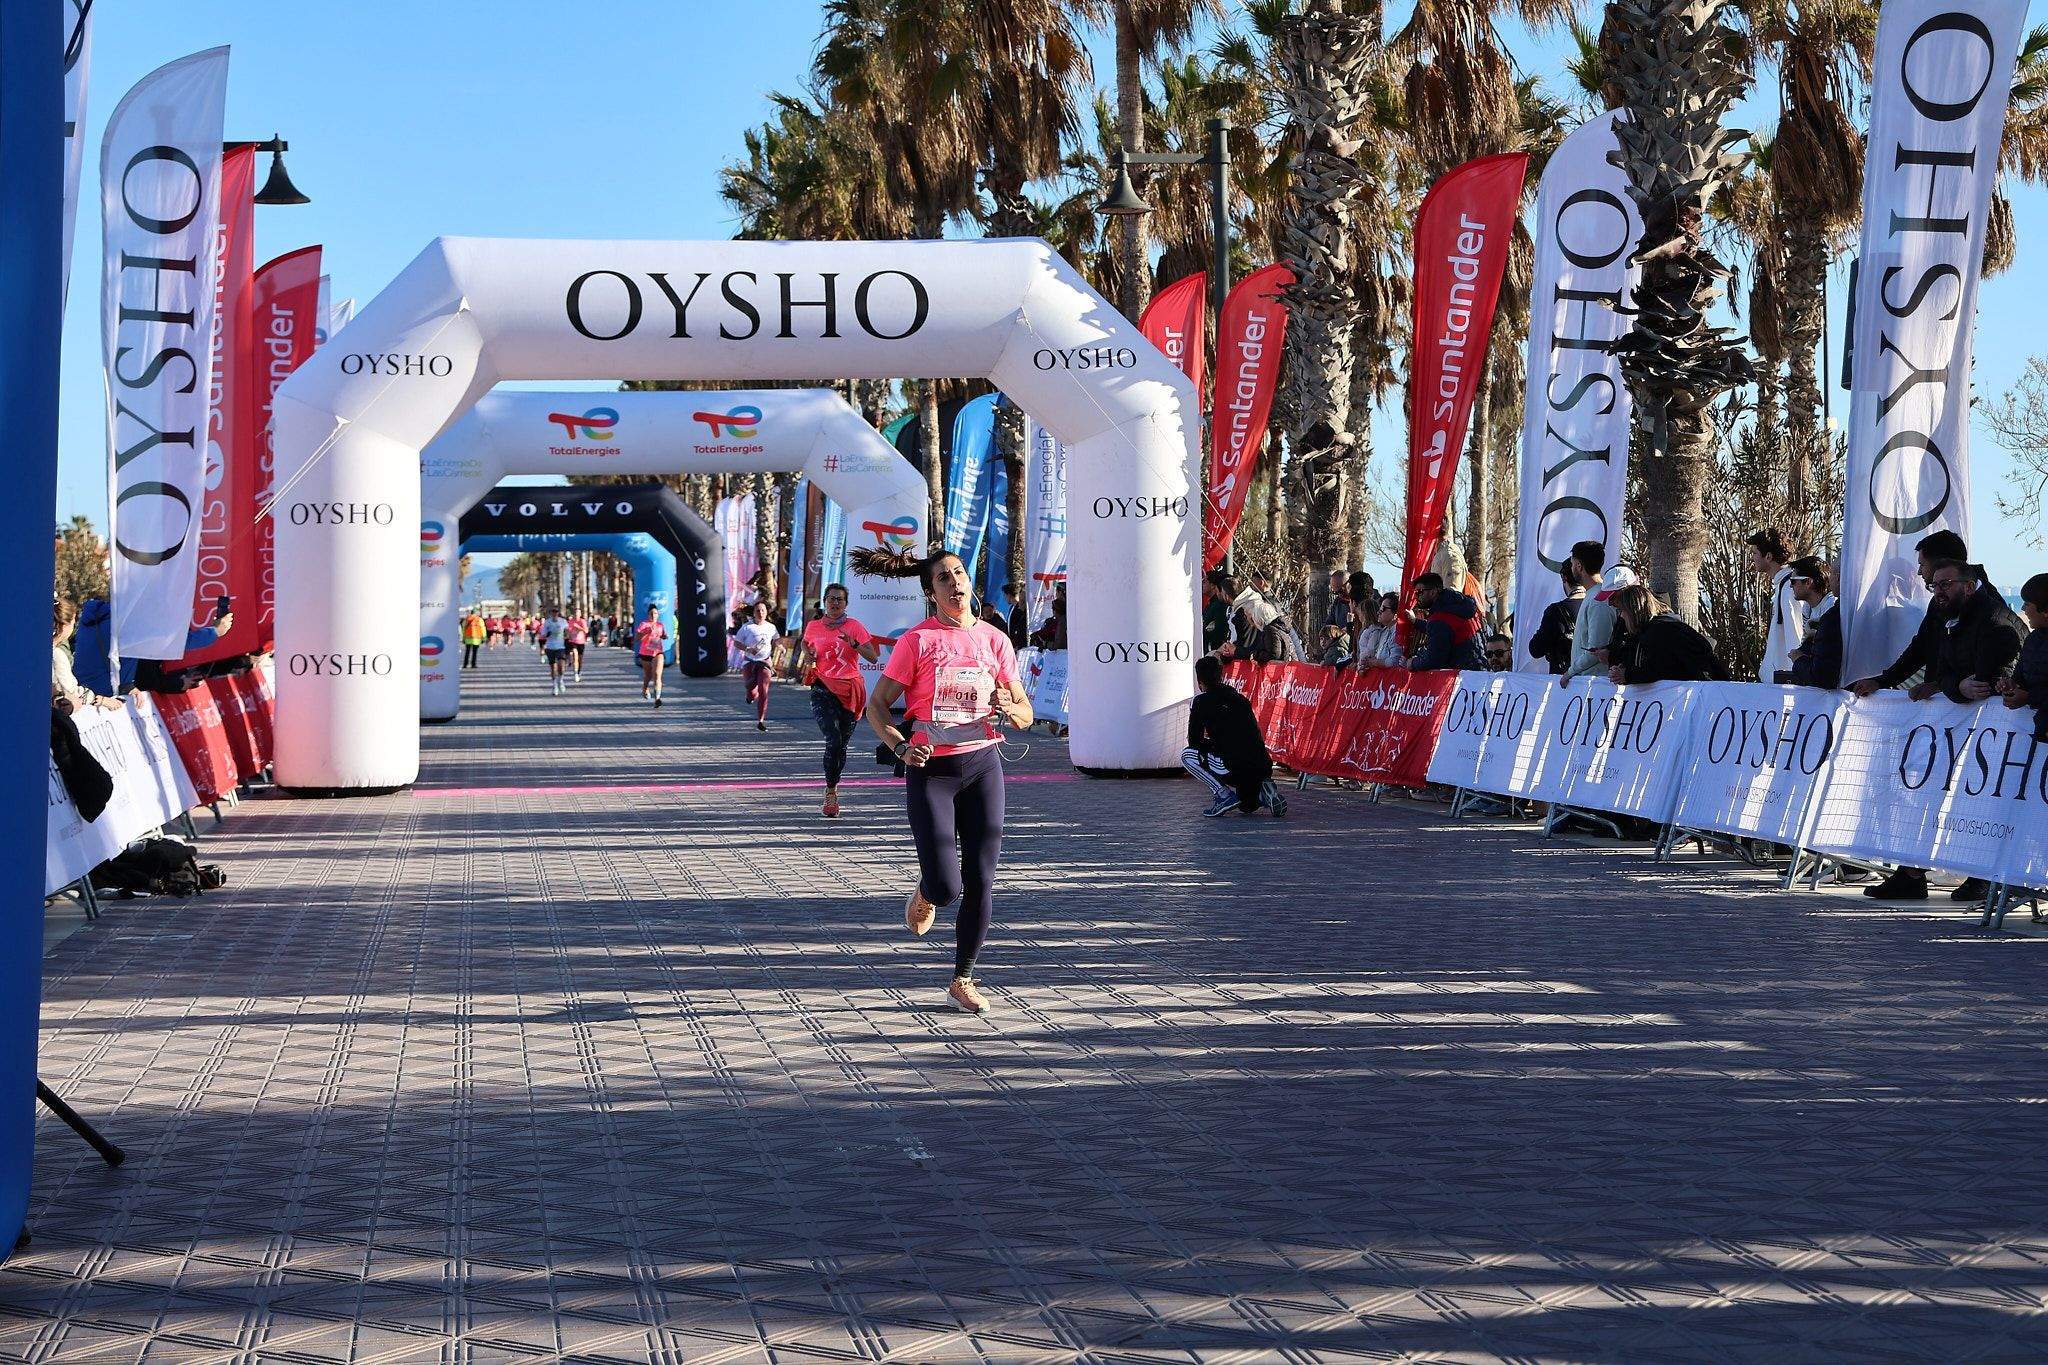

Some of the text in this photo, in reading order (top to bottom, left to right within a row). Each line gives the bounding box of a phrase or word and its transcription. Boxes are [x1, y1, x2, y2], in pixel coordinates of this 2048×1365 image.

[1870, 12, 1996, 535] OYSHO
[565, 270, 930, 341] OYSHO
[1433, 213, 1487, 422] Santander
[116, 145, 202, 566] OYSHO
[340, 353, 452, 377] OYSHO
[1033, 348, 1138, 371] OYSHO
[1222, 311, 1268, 468] Santander
[1537, 188, 1631, 574] OYSHO
[549, 447, 621, 457] TotalEnergies
[693, 445, 764, 455] TotalEnergies
[290, 502, 394, 526] OYSHO
[484, 501, 634, 517] VOLVO
[1093, 496, 1189, 519] OYSHO
[694, 557, 708, 661] VOLVO
[860, 593, 917, 603] totalenergies.es
[289, 653, 393, 677] OYSHO
[1094, 641, 1190, 665] OYSHO
[1384, 684, 1438, 716] Santander
[1447, 688, 1529, 740] OYSHO
[1560, 696, 1664, 753] OYSHO
[1708, 706, 1834, 775] OYSHO
